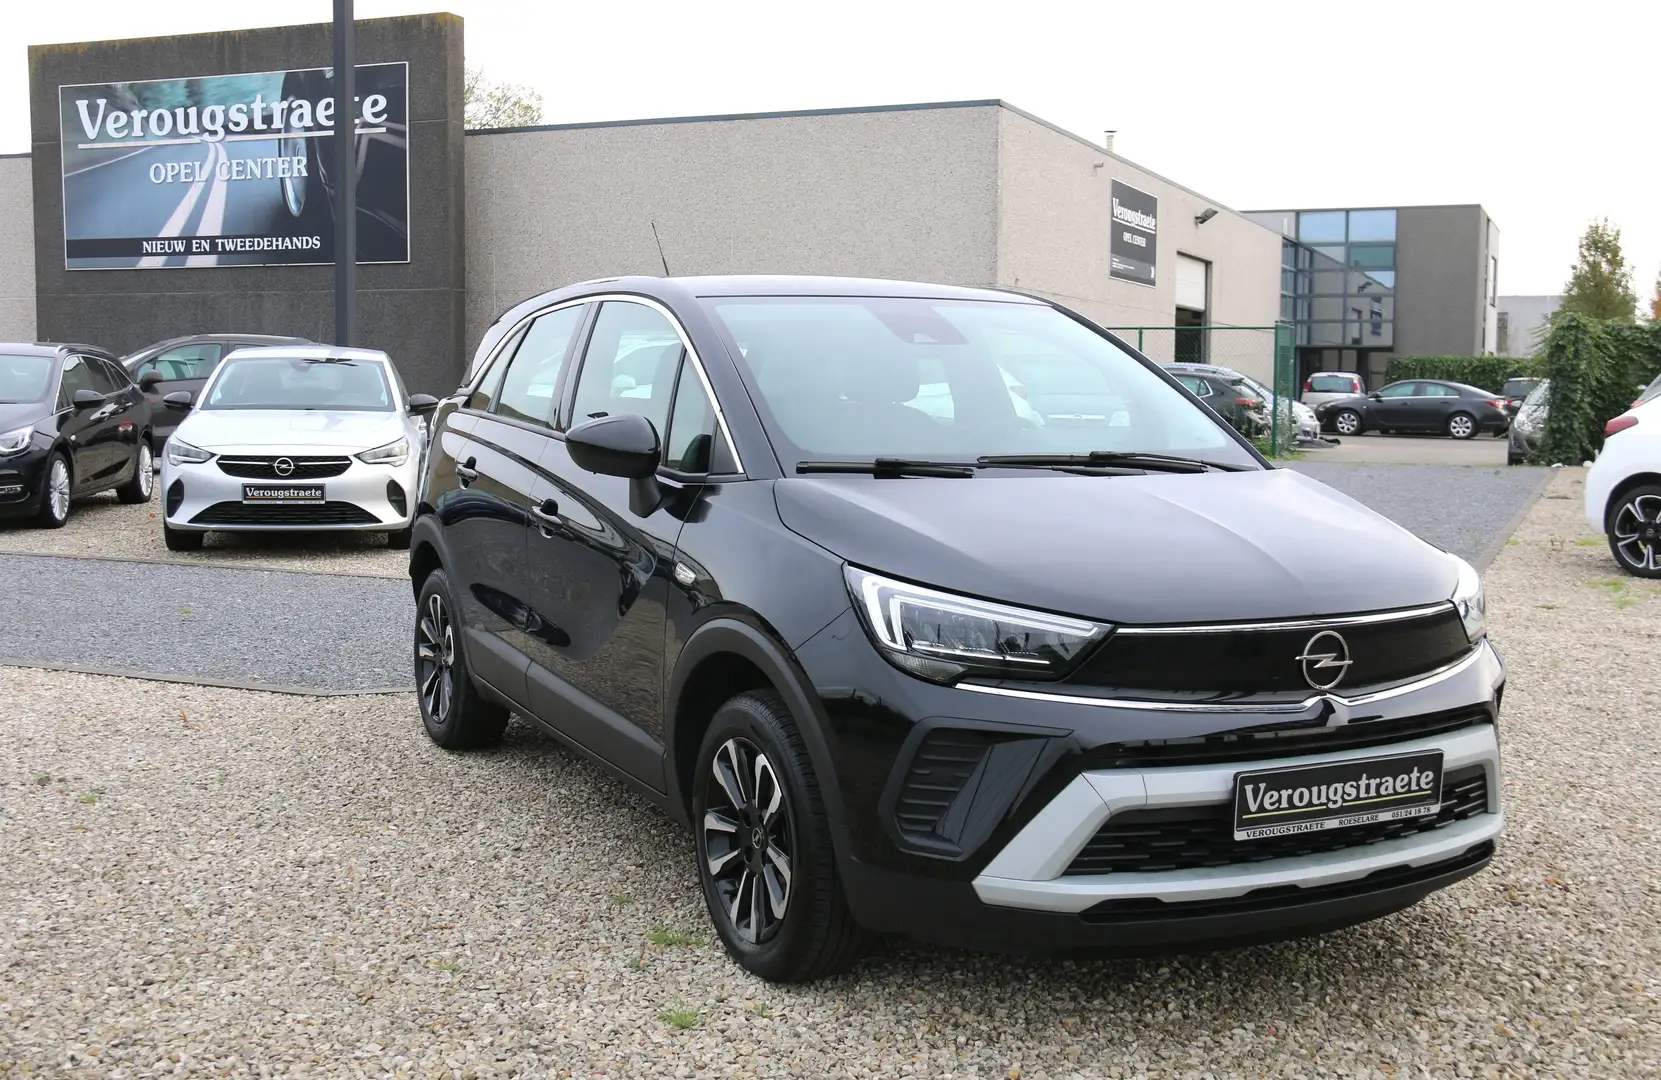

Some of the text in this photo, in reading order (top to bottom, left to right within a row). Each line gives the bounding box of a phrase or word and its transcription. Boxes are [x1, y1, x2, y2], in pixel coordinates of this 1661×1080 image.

[75, 93, 388, 142] Verougstraee
[149, 157, 308, 184] OPEL CENTER
[1112, 197, 1156, 230] Verougstraete
[142, 236, 321, 254] NIEUW EN TWEEDEHANDS
[245, 487, 322, 499] Verougstraete
[1244, 766, 1434, 812] Verougstraete
[1246, 821, 1325, 838] VEROUGSTRAETE
[1338, 814, 1379, 827] ROESELARE
